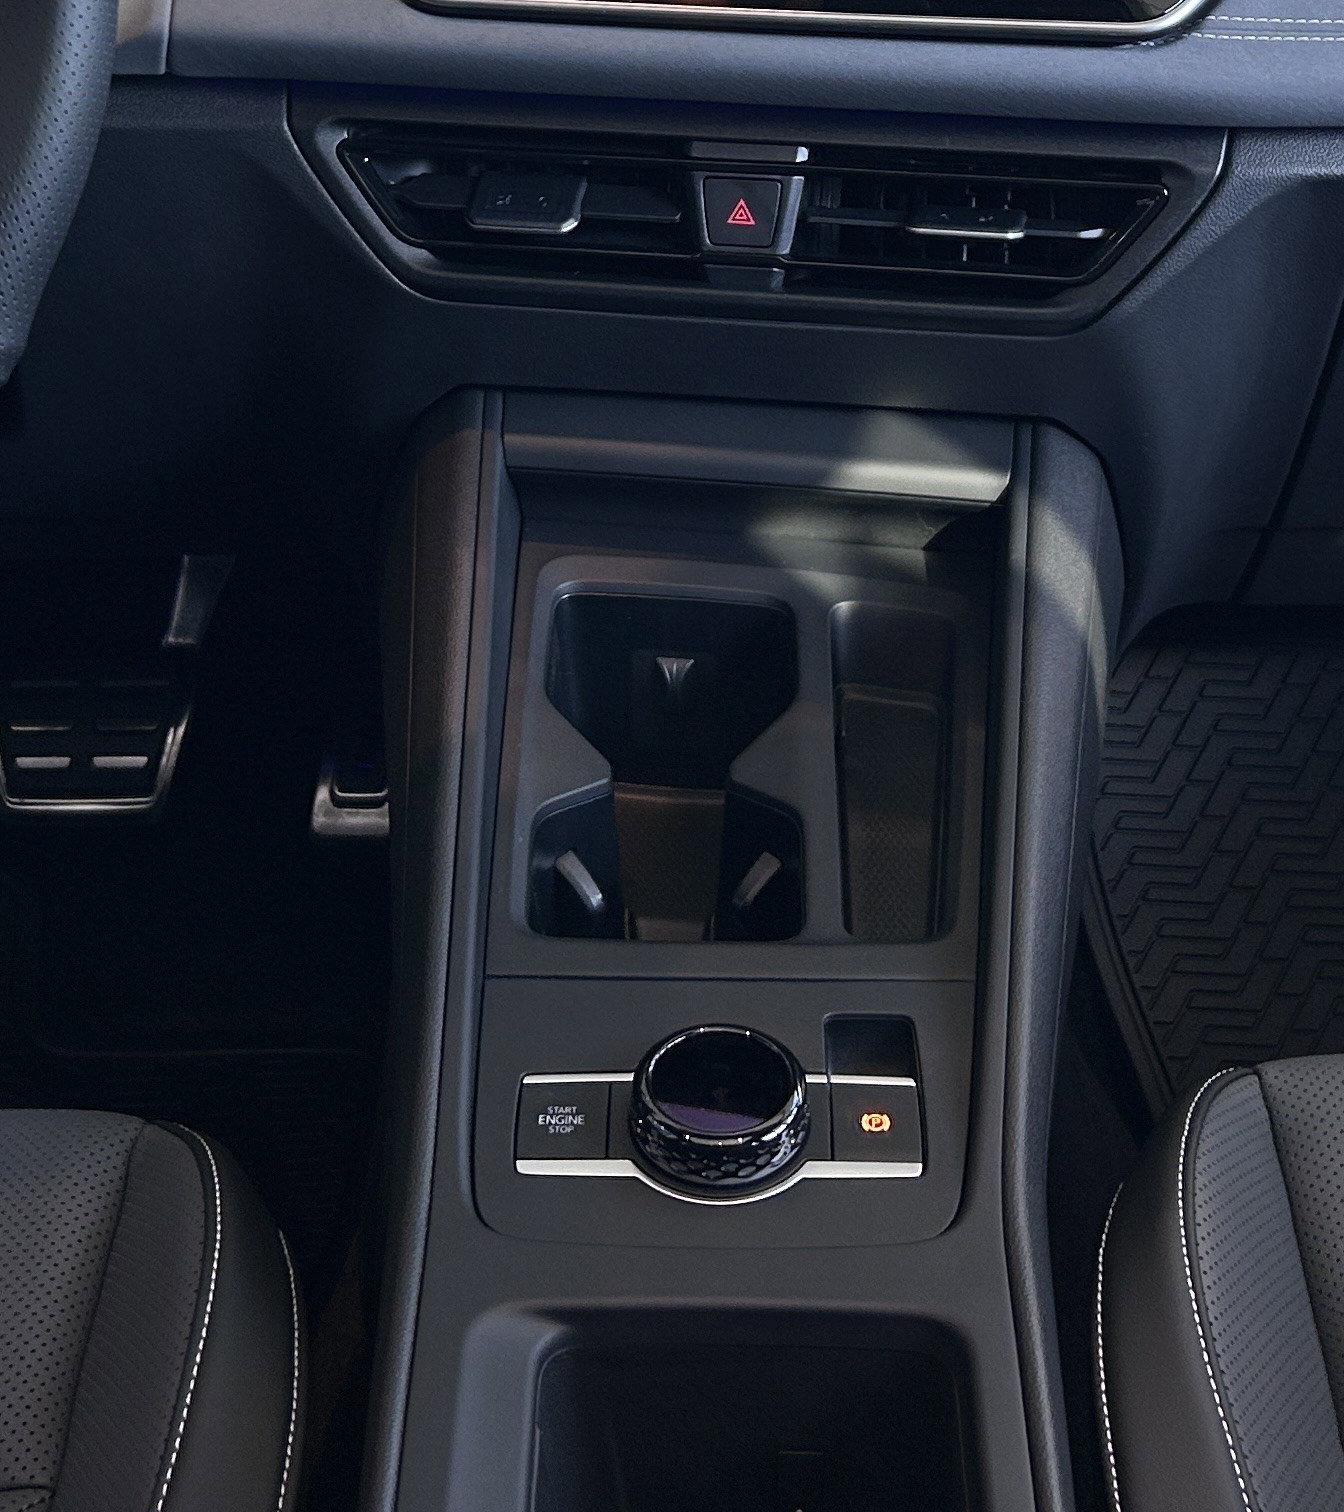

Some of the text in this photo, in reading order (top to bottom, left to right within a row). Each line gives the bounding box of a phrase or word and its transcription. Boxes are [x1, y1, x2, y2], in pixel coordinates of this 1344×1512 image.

[547, 1105, 577, 1115] START
[538, 1114, 586, 1125] ENGINE
[548, 1125, 575, 1134] STOP
